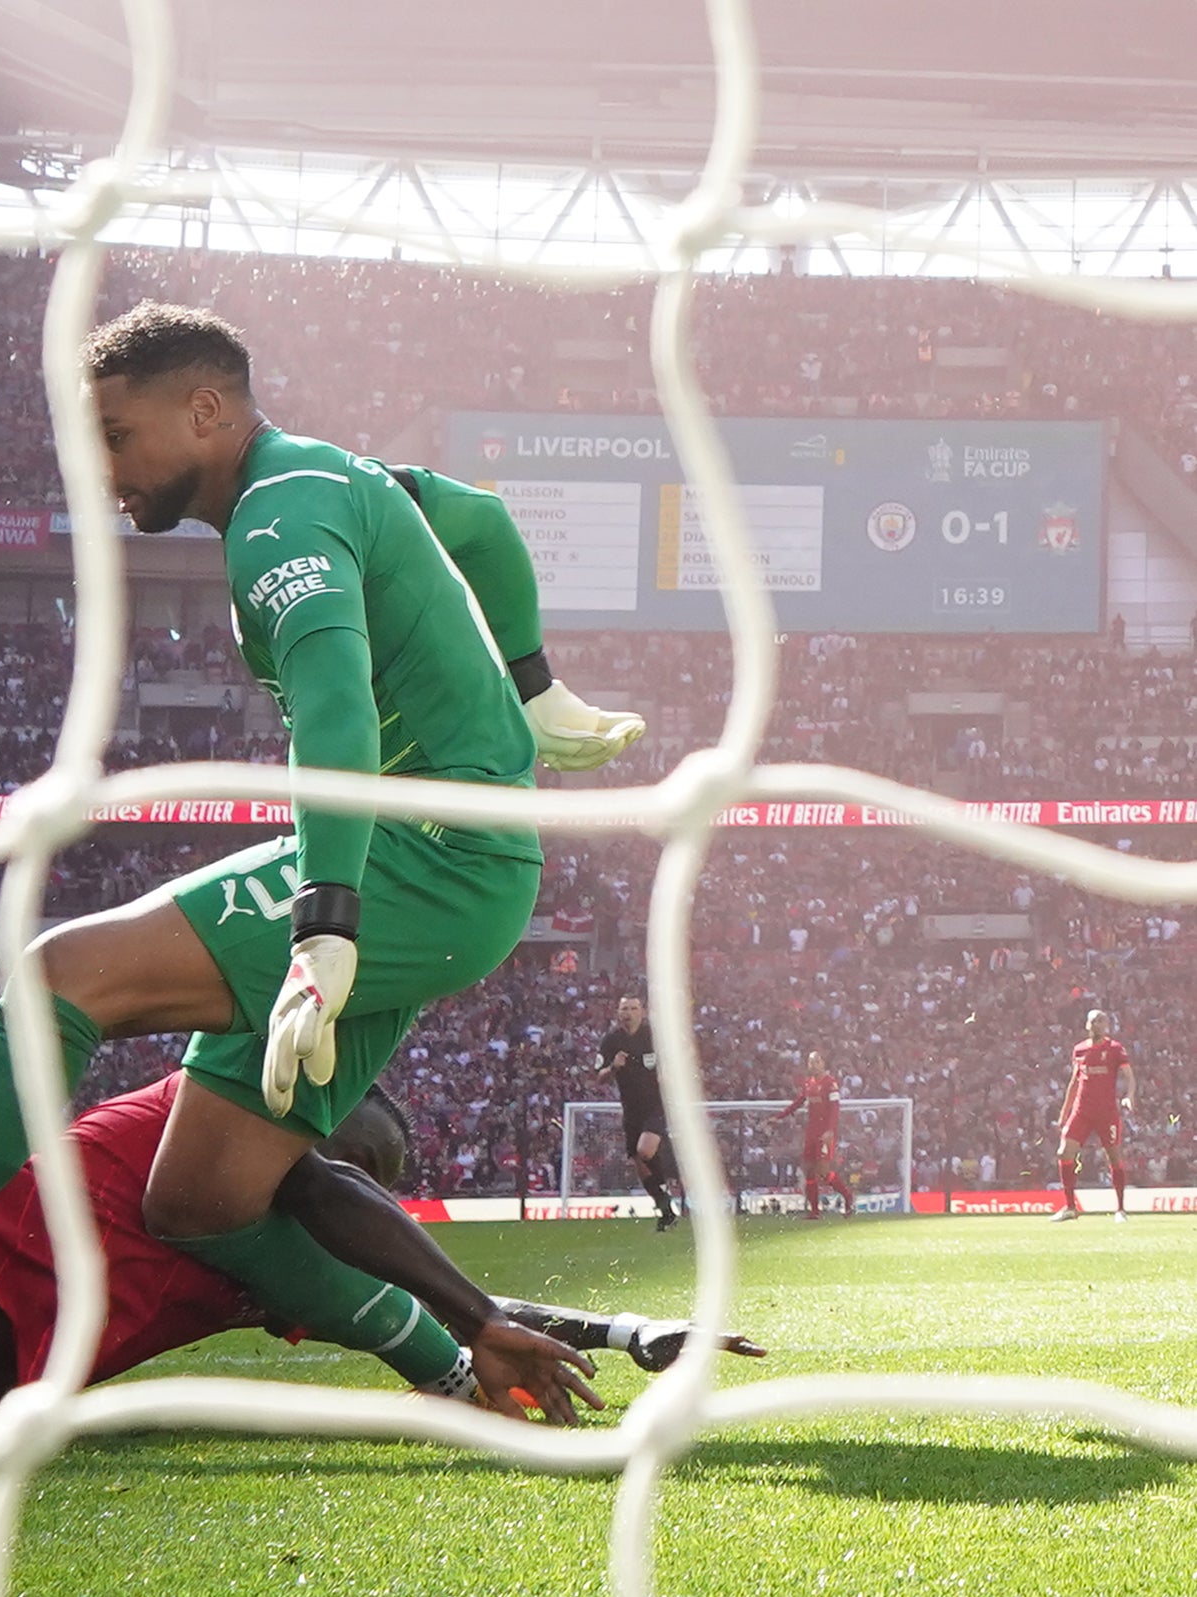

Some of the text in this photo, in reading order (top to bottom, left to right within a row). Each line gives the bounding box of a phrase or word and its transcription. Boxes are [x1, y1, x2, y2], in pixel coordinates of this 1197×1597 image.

[517, 435, 671, 460] LIVERPOOL
[963, 446, 1031, 461] Emirates
[963, 461, 1031, 478] FA CUP
[502, 486, 564, 499] ALISSON
[509, 507, 566, 519] ABINHO
[535, 529, 569, 541] DIJK
[941, 510, 1009, 544] 0-1
[247, 555, 332, 610] NEXEN
[265, 573, 327, 615] TIRE
[941, 587, 1005, 606] 16:39
[149, 800, 179, 823] FLY
[177, 801, 234, 824] BETTER
[765, 804, 794, 825] FLY
[792, 803, 846, 826] BETTER
[964, 803, 989, 823] FLY
[990, 803, 1042, 824] BETTER
[1057, 802, 1153, 823] Emirates
[1158, 802, 1186, 824] FLY
[950, 1199, 1056, 1214] Emirates
